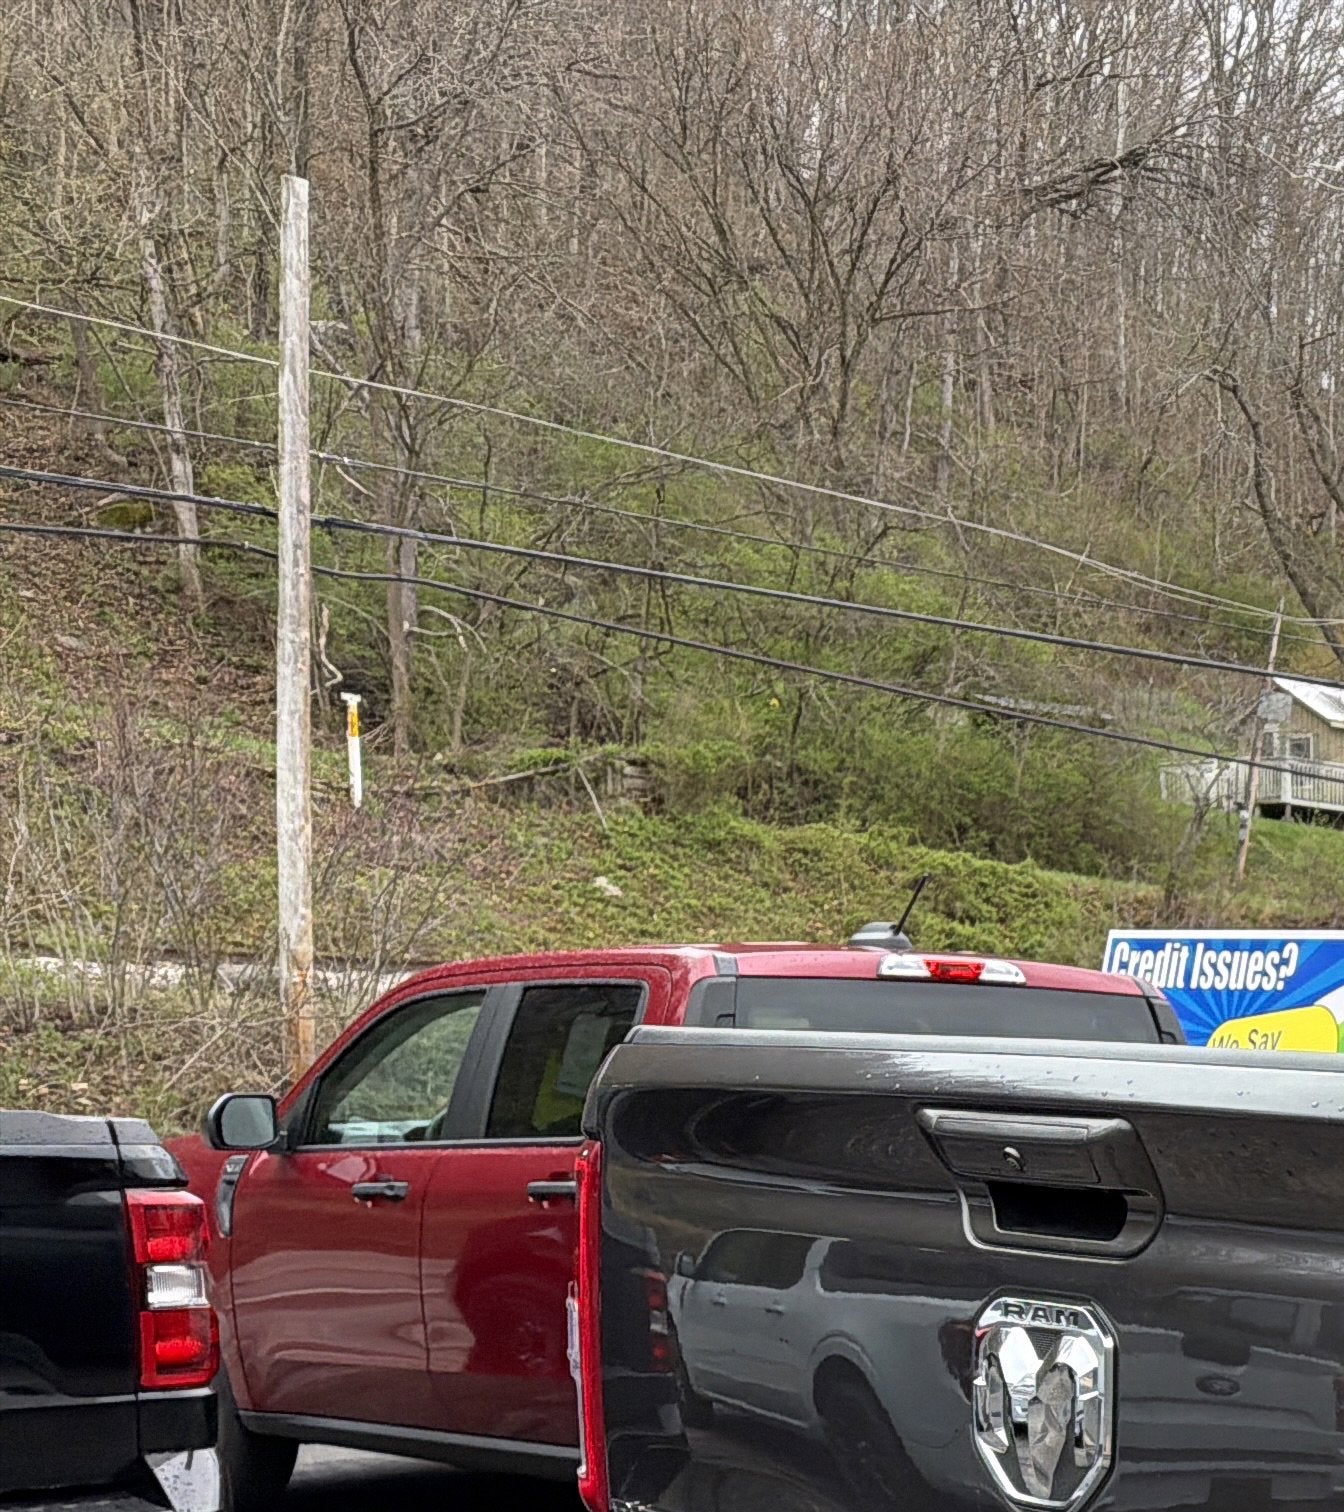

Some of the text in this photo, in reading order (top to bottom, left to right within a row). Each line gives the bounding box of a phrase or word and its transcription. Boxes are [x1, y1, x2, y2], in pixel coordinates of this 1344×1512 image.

[1111, 941, 1299, 991] Credit Issues?
[1002, 1301, 1080, 1328] RAM
